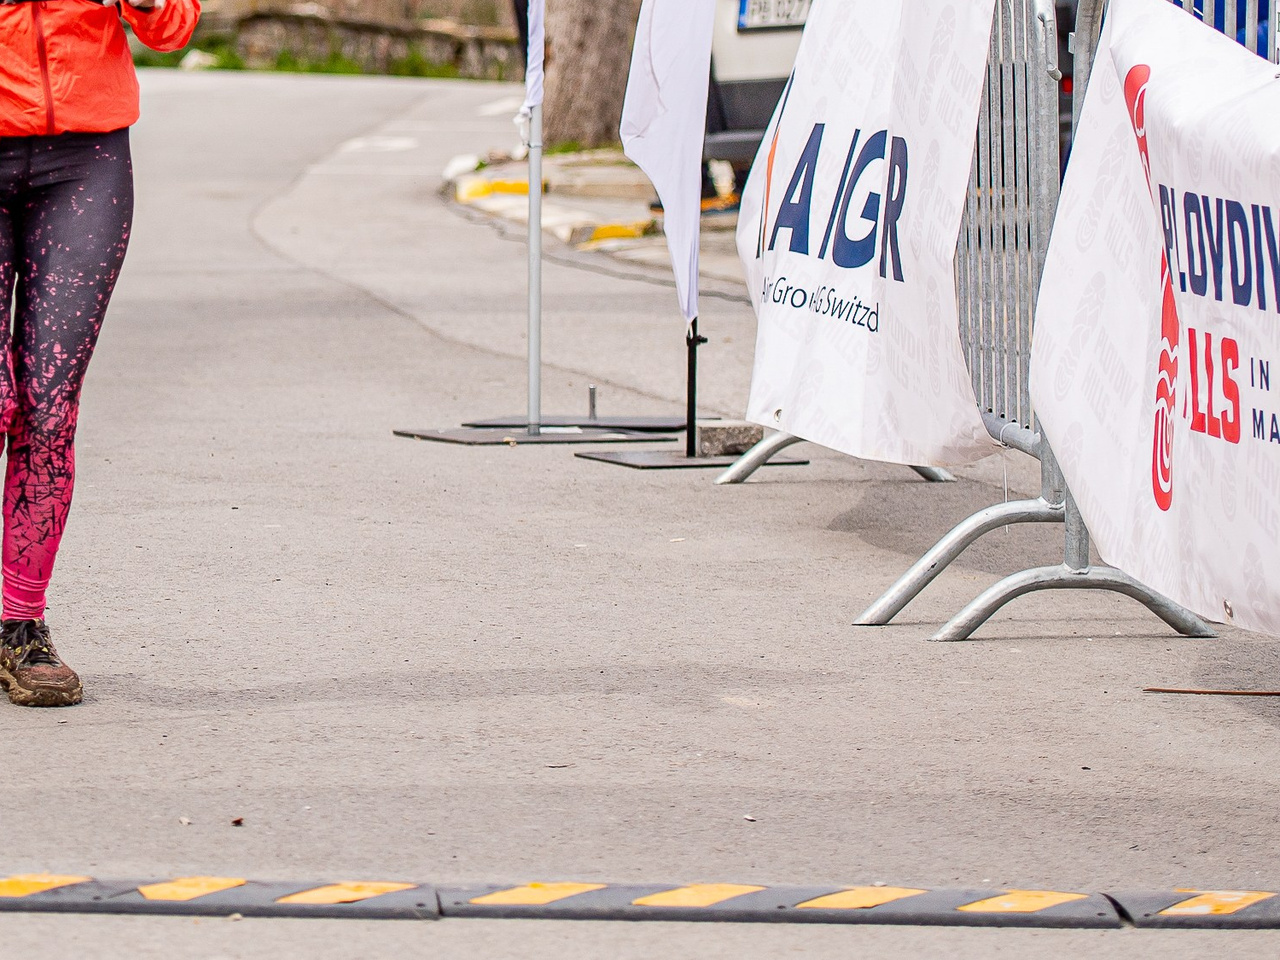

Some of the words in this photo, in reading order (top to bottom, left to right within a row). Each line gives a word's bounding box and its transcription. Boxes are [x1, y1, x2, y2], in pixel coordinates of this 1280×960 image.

[1183, 327, 1240, 445] LLS
[1250, 356, 1271, 393] IN
[1252, 407, 1280, 445] MA
